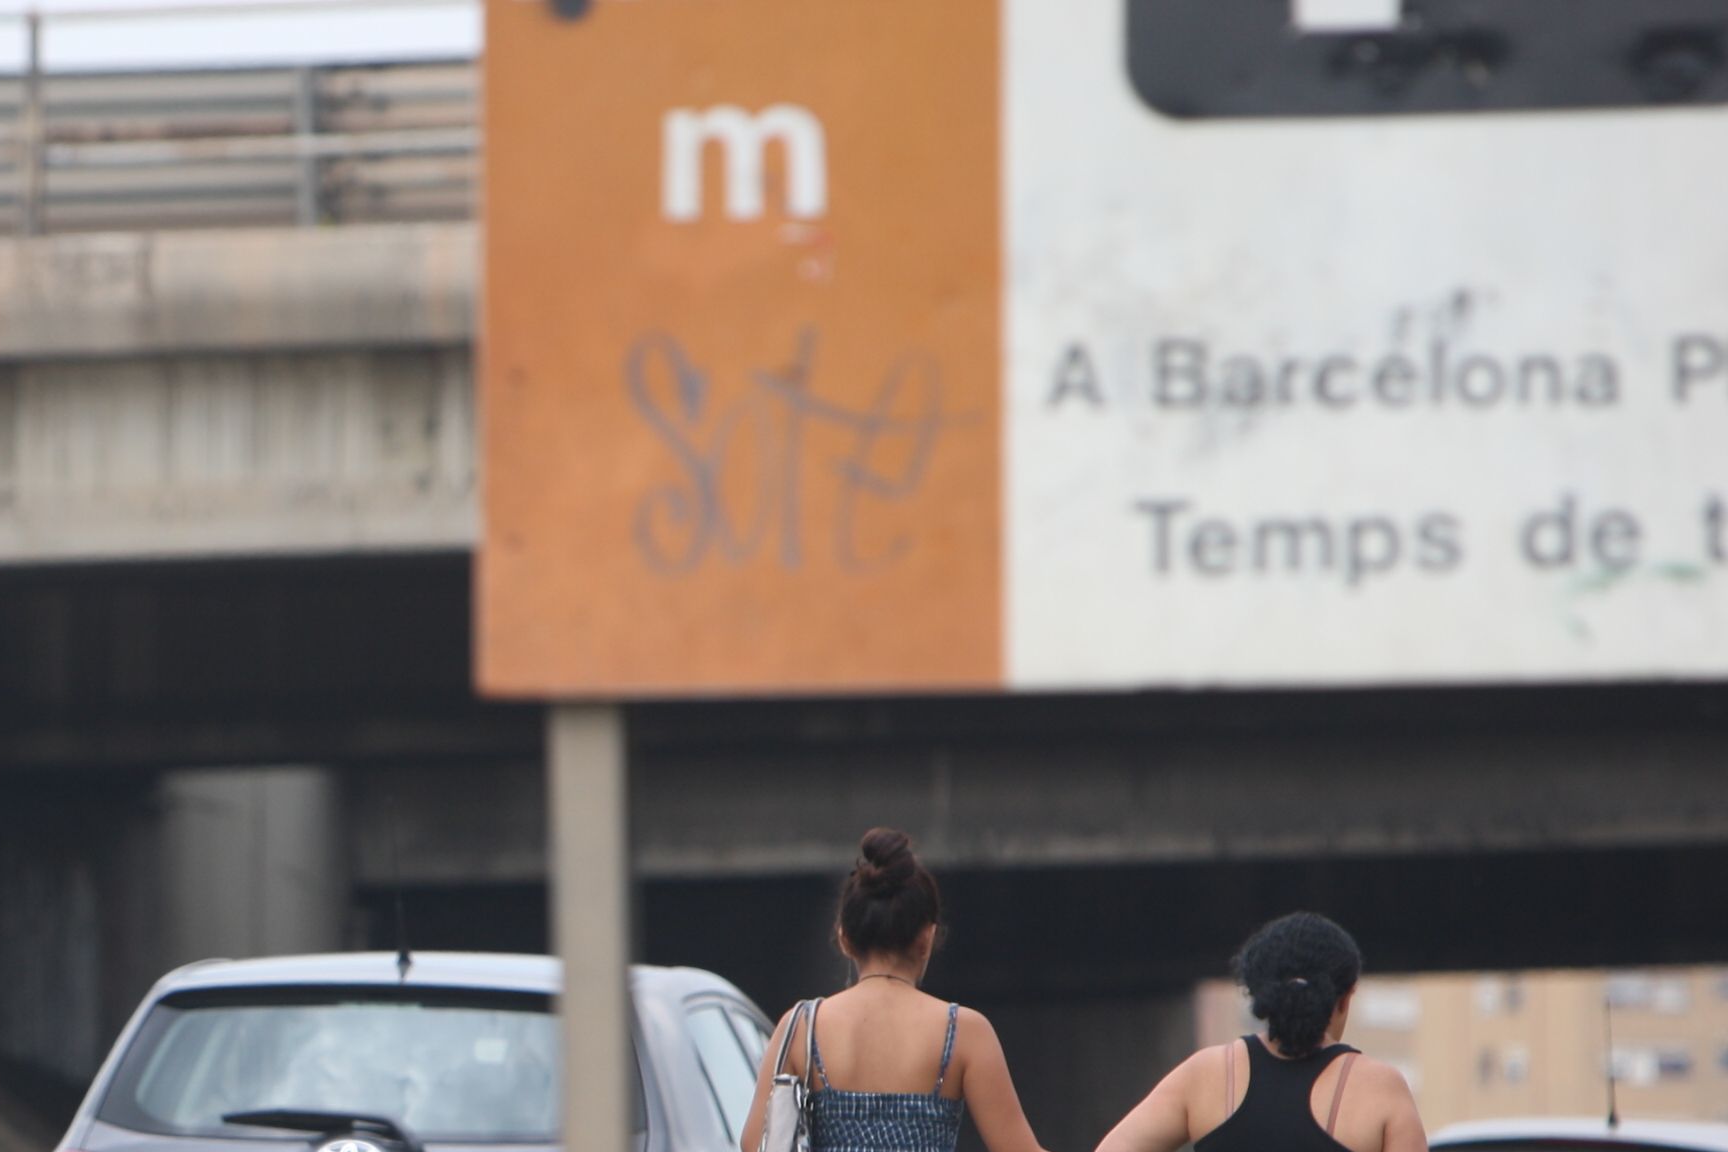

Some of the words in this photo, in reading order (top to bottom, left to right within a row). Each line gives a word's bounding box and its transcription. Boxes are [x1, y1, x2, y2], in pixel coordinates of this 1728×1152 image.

[662, 104, 827, 221] m
[1048, 340, 1104, 409] A
[1152, 336, 1621, 409] Barcelona
[1668, 332, 1728, 405] P
[1134, 497, 1463, 588] Temps
[1521, 495, 1643, 571] de
